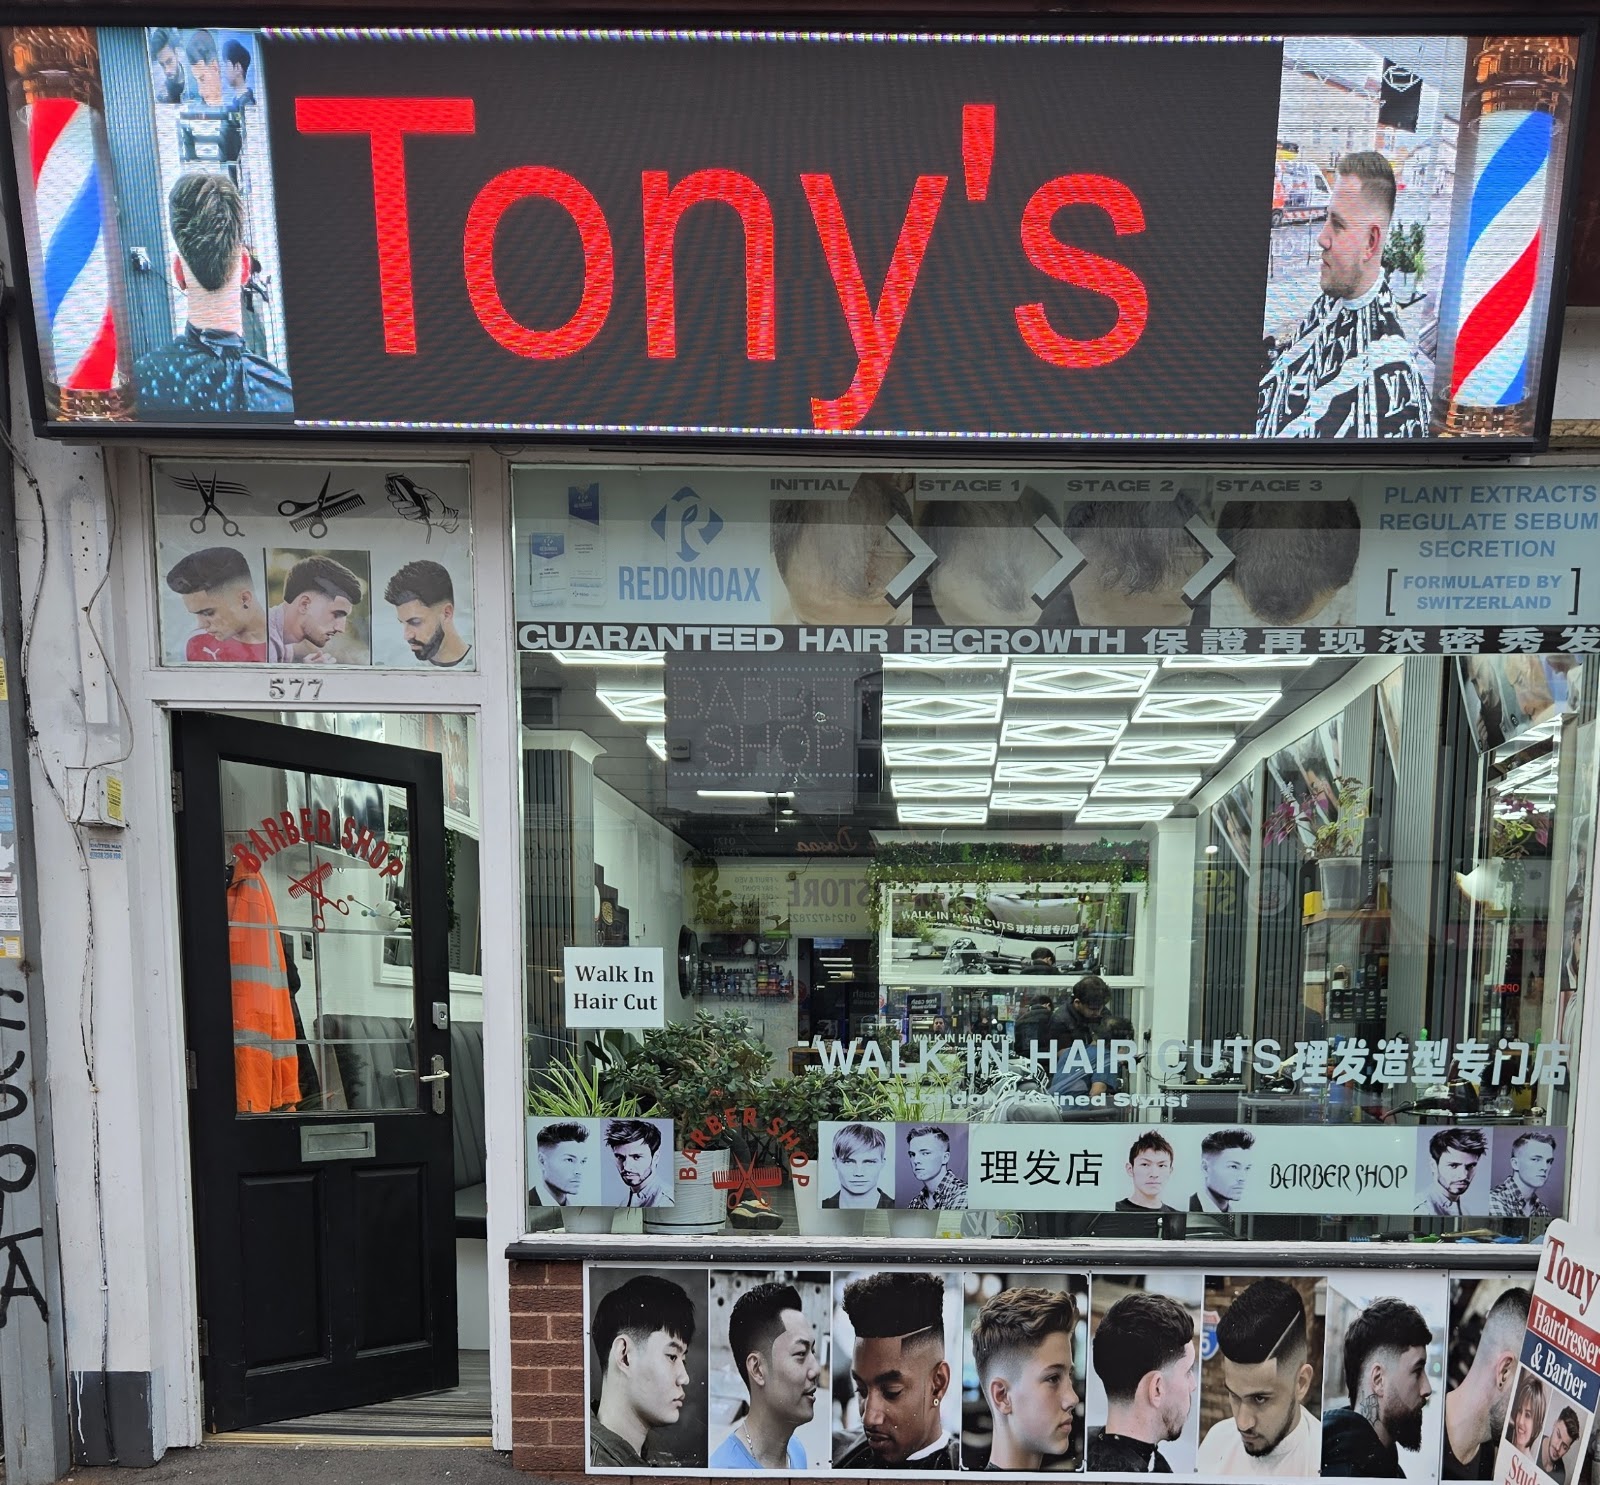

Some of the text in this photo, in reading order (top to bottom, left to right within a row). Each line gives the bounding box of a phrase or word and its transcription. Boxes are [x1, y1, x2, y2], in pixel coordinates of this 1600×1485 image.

[294, 97, 1149, 431] Tony's
[769, 479, 850, 492] INITIAL
[918, 479, 1021, 493] STAGE 1
[1066, 480, 1175, 493] STAGE 2
[1216, 480, 1324, 493] STAGE 3
[1384, 485, 1598, 504] PLANT EXTRACTS
[1380, 512, 1599, 531] REGULATE SEBUM
[1419, 539, 1556, 559] SECRETION
[618, 566, 762, 603] REDONOAX
[1403, 575, 1563, 590] FORMULATED BY
[1416, 596, 1552, 610] SWITZERLAND
[518, 624, 1126, 654] GUARANTEED HAIR REGROWTH
[269, 678, 325, 701] 577
[673, 676, 873, 720] BARBER
[704, 724, 846, 768] SHOP
[232, 808, 404, 878] BARBER SHOP
[984, 918, 1015, 931] CUTS
[575, 964, 655, 983] Walk In
[573, 993, 658, 1012] Hair Cut
[958, 1033, 982, 1044] HAIR
[985, 1033, 1016, 1044] CUTS
[816, 1039, 1282, 1075] WALK IN HAIR CUTS
[1292, 1036, 1571, 1087] 理发造型专门店
[1113, 1092, 1188, 1108] Stylist
[679, 1107, 811, 1188] BARBER SHOP
[979, 1148, 1103, 1188] 理发店
[1269, 1162, 1408, 1197] BARBER SHOP
[1543, 1234, 1600, 1317] Tony
[1532, 1300, 1600, 1368] Hairdresser
[1530, 1342, 1588, 1401] & Barber
[1508, 1453, 1540, 1485] Stud
